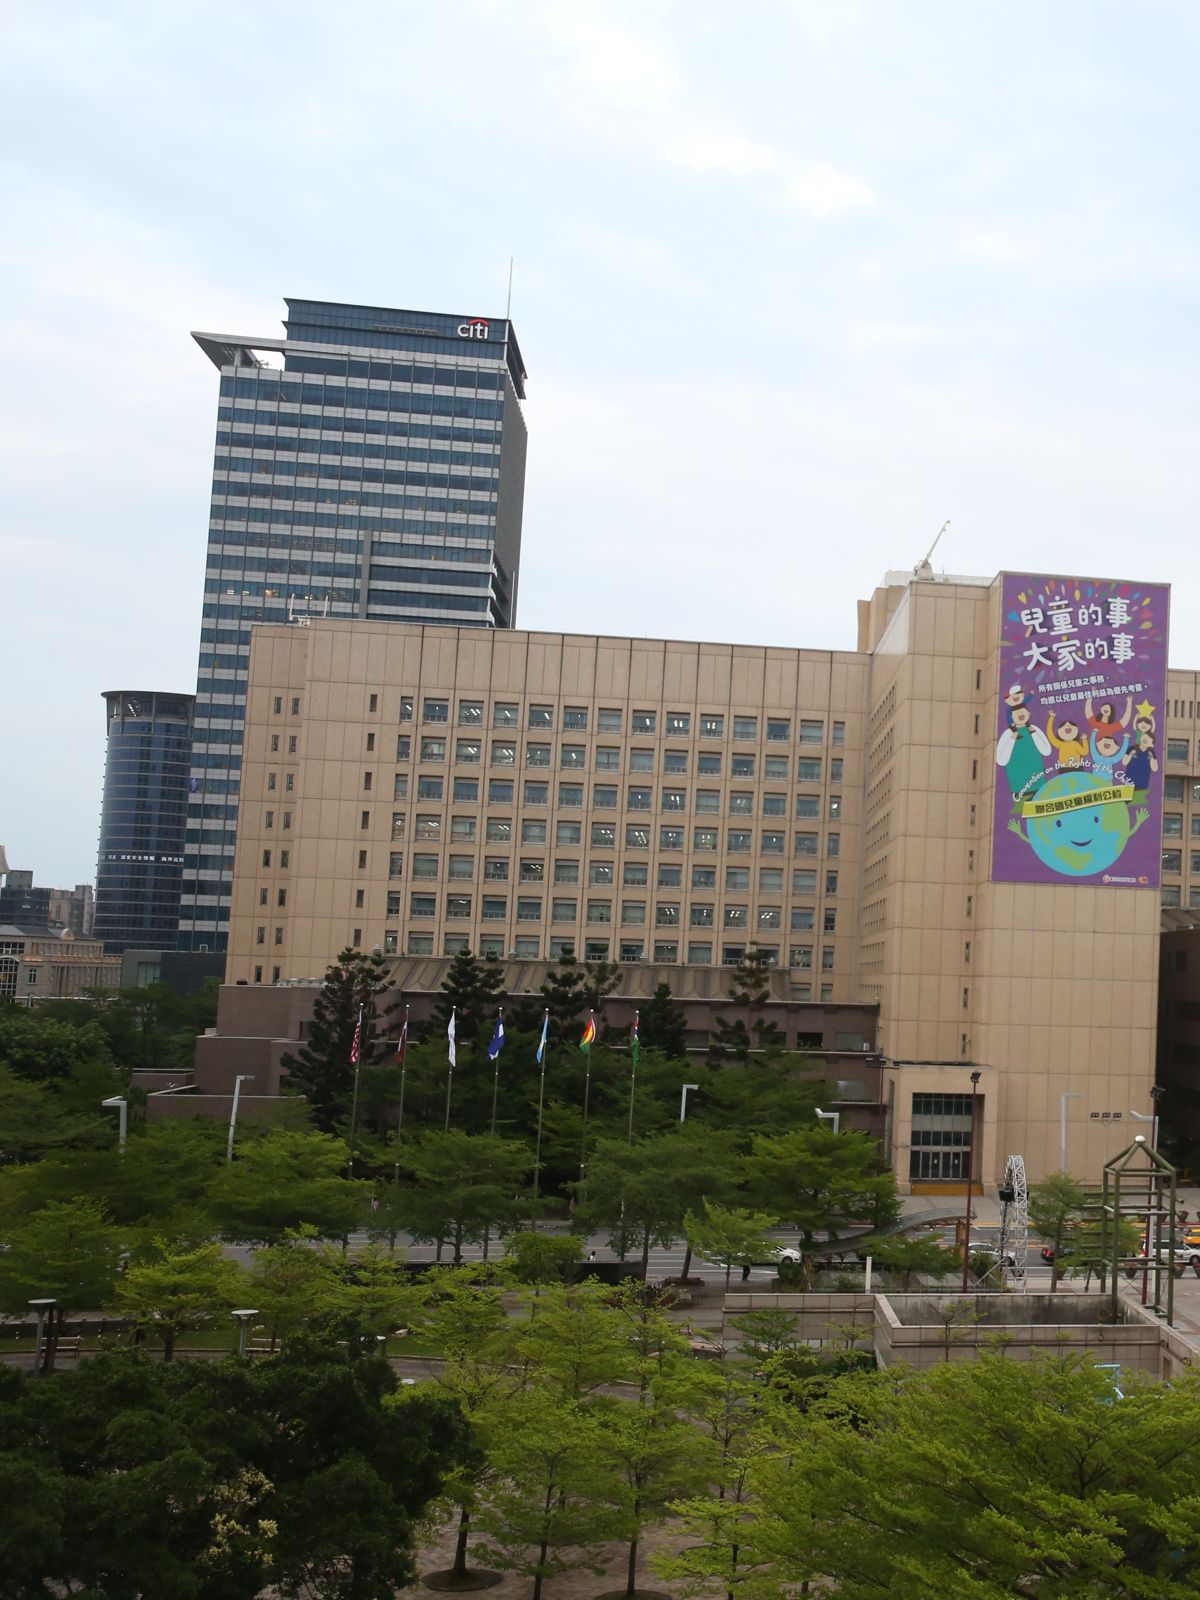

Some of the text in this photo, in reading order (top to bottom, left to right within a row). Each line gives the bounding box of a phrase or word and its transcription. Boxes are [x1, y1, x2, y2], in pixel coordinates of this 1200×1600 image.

[457, 320, 489, 340] citi
[1021, 596, 1131, 635] 兒童的事
[1023, 632, 1135, 671] 大家的事
[1012, 771, 1045, 802] Convention
[1045, 765, 1055, 775] on
[1054, 760, 1068, 770] the
[1068, 757, 1092, 769] Rights
[1092, 762, 1104, 772] of
[1114, 770, 1136, 788] Child
